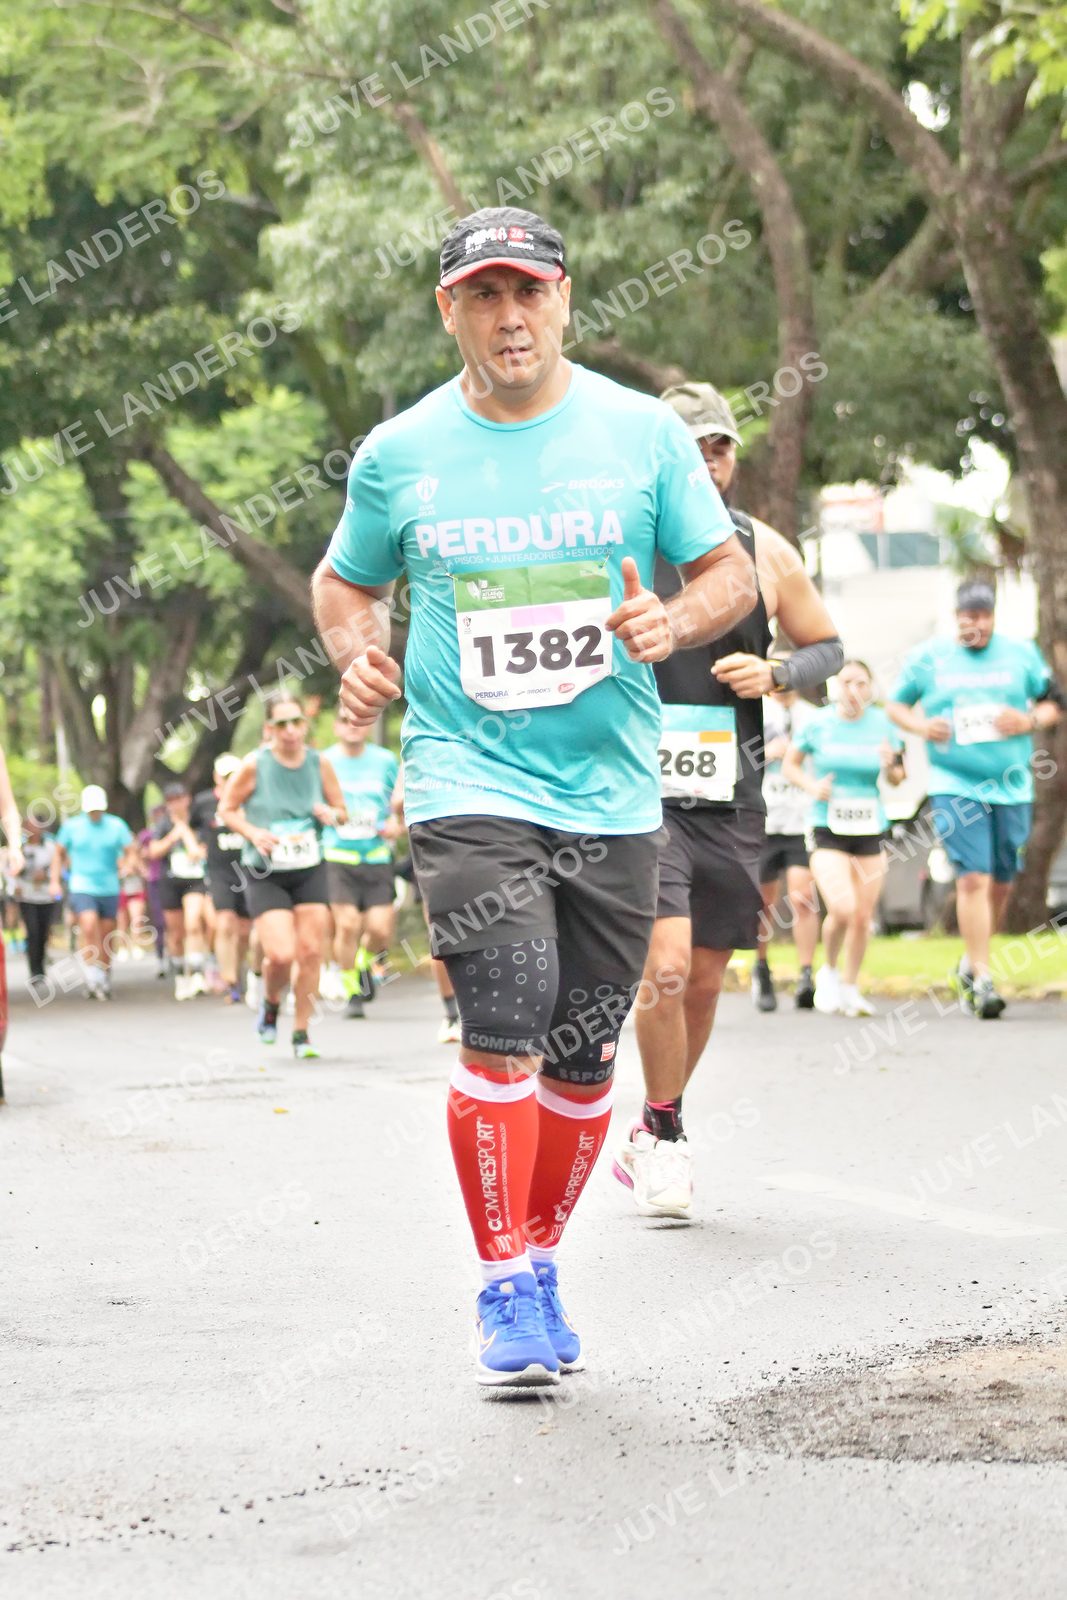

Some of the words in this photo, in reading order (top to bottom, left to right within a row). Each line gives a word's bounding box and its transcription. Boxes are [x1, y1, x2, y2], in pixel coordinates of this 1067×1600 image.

[567, 478, 625, 490] BROOKS
[414, 509, 625, 559] PERDURA
[491, 550, 565, 564] JUNTEADORES
[571, 546, 615, 558] ESTUCOS
[472, 624, 605, 678] 1382
[475, 690, 509, 700] PERDURA
[657, 748, 718, 778] 268
[469, 1032, 534, 1052] COMPRE
